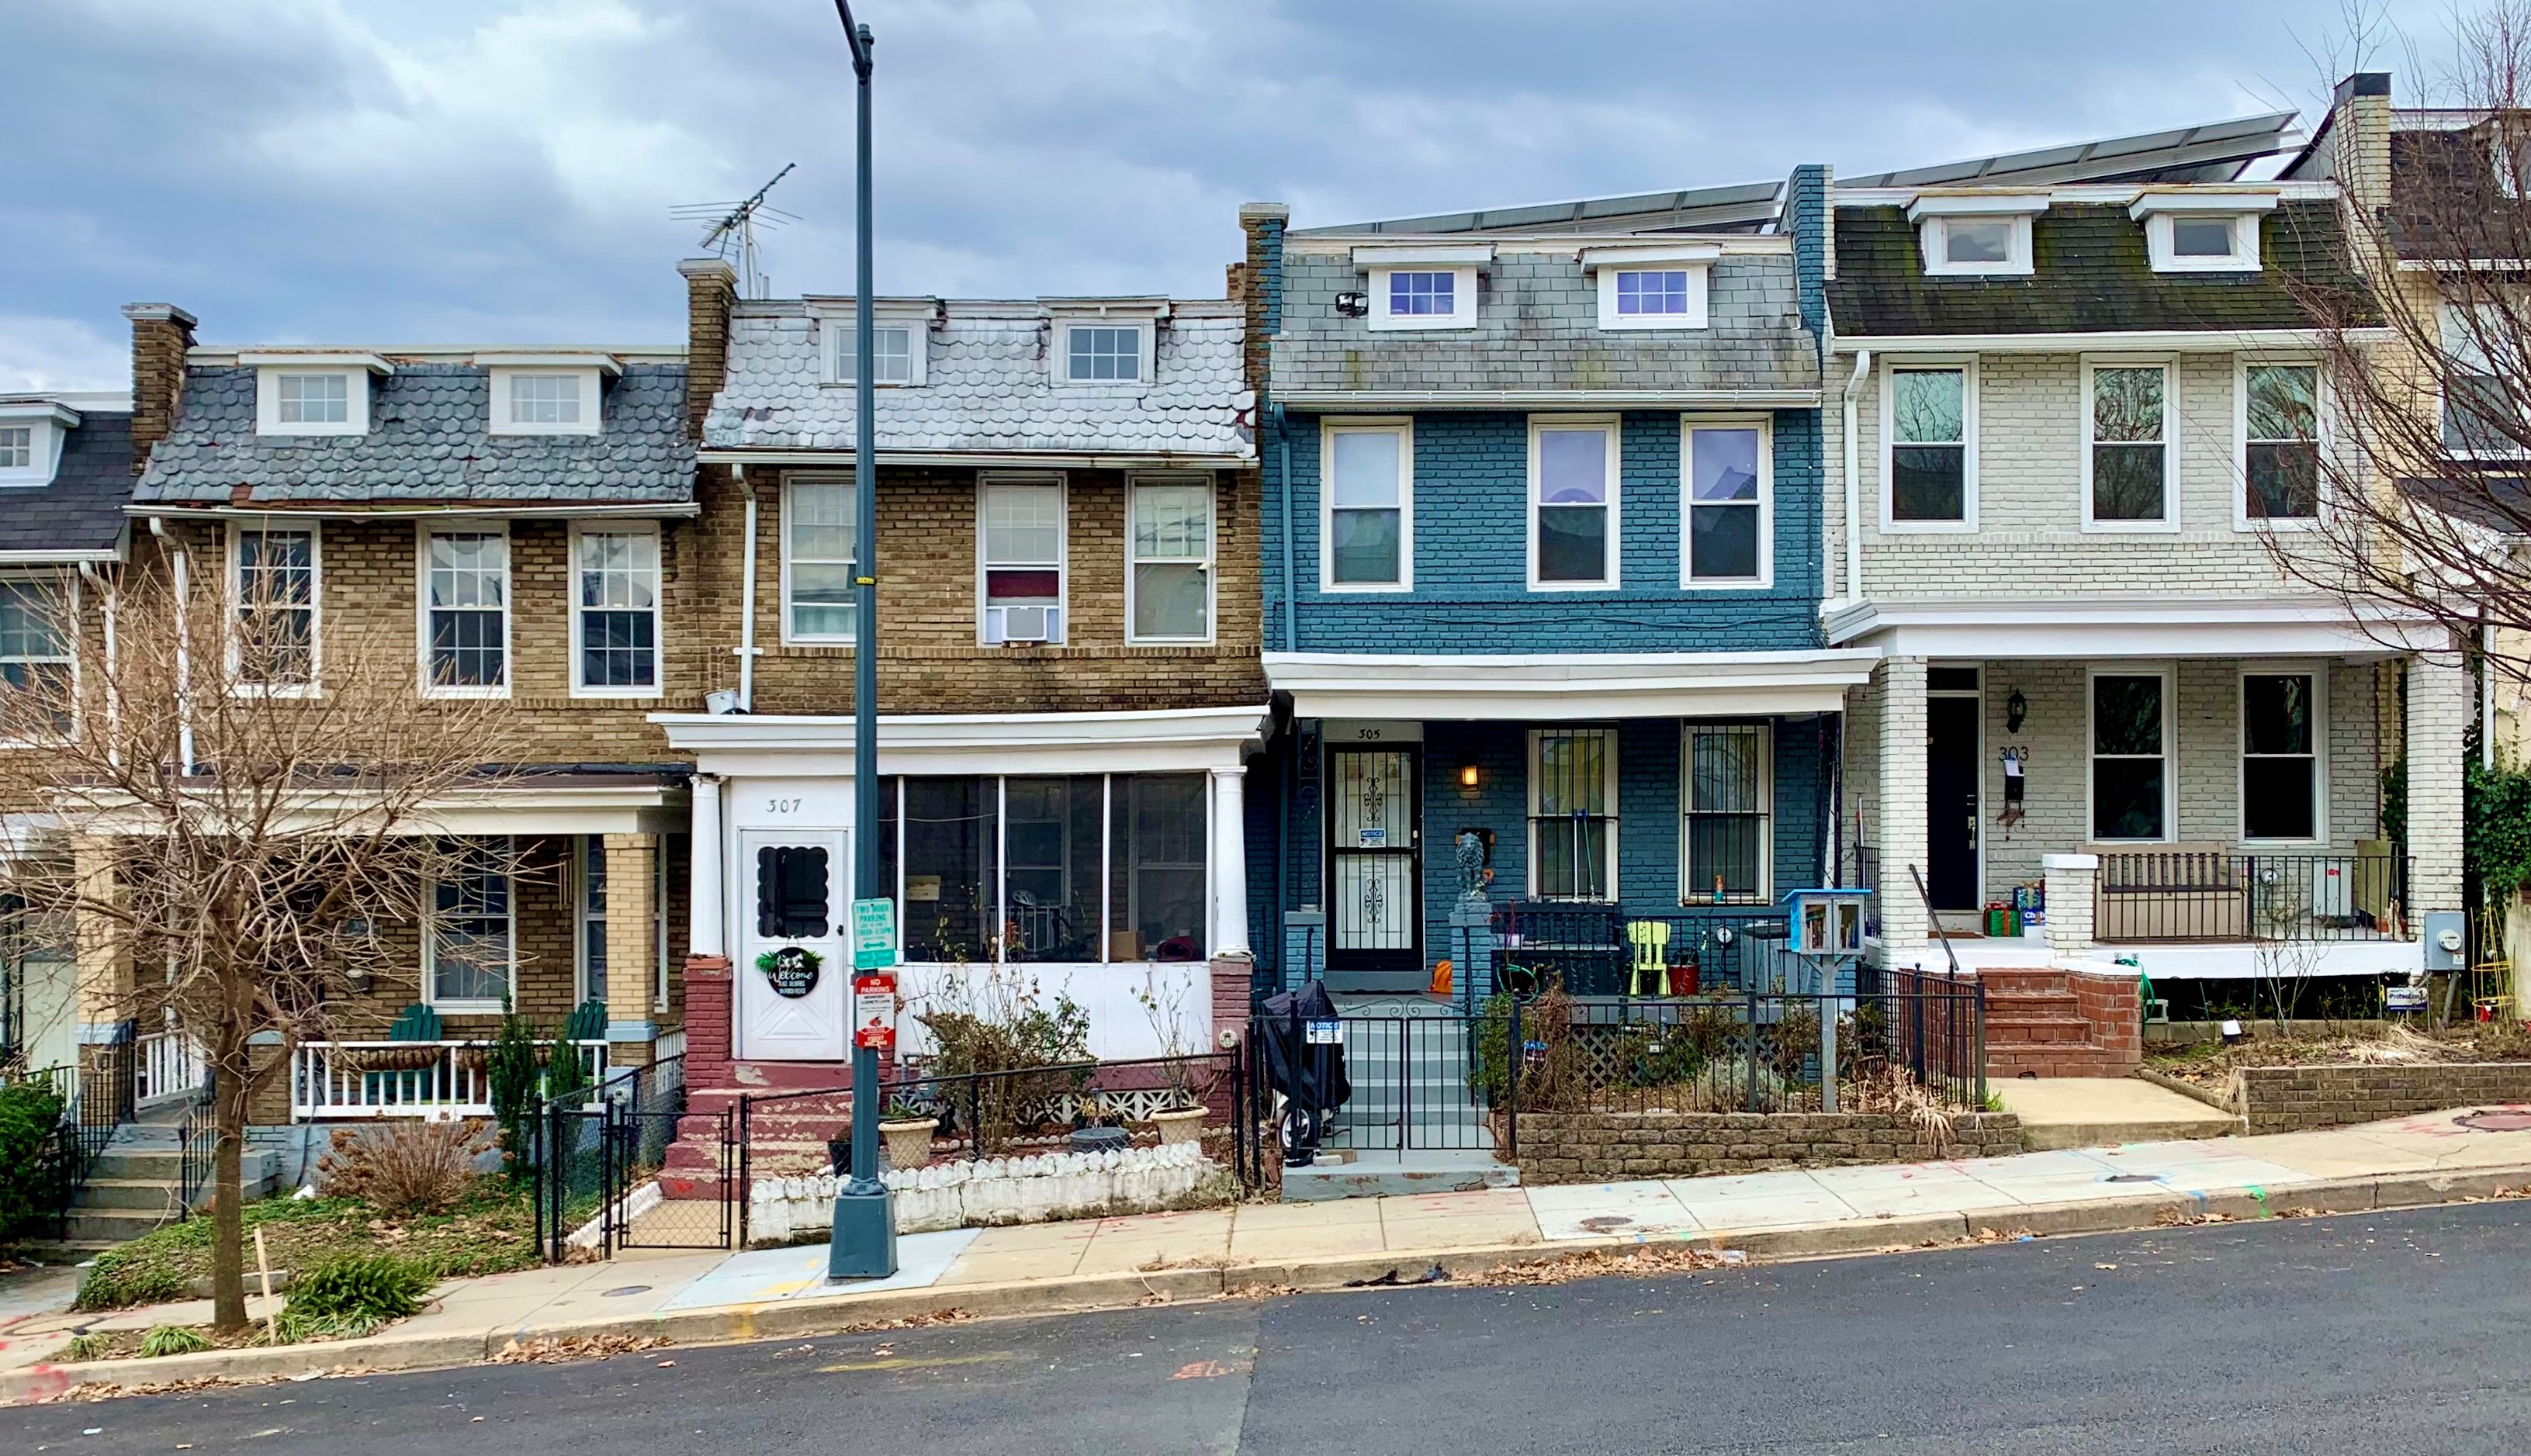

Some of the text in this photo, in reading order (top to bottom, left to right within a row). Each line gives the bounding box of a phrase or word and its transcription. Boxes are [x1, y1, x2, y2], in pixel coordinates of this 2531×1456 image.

[1358, 729, 1380, 739] 305
[1998, 745, 2029, 762] 303
[766, 798, 802, 813] 307
[859, 914, 887, 923] PARKING
[768, 966, 814, 983] Welcome
[860, 985, 891, 994] PARKING
